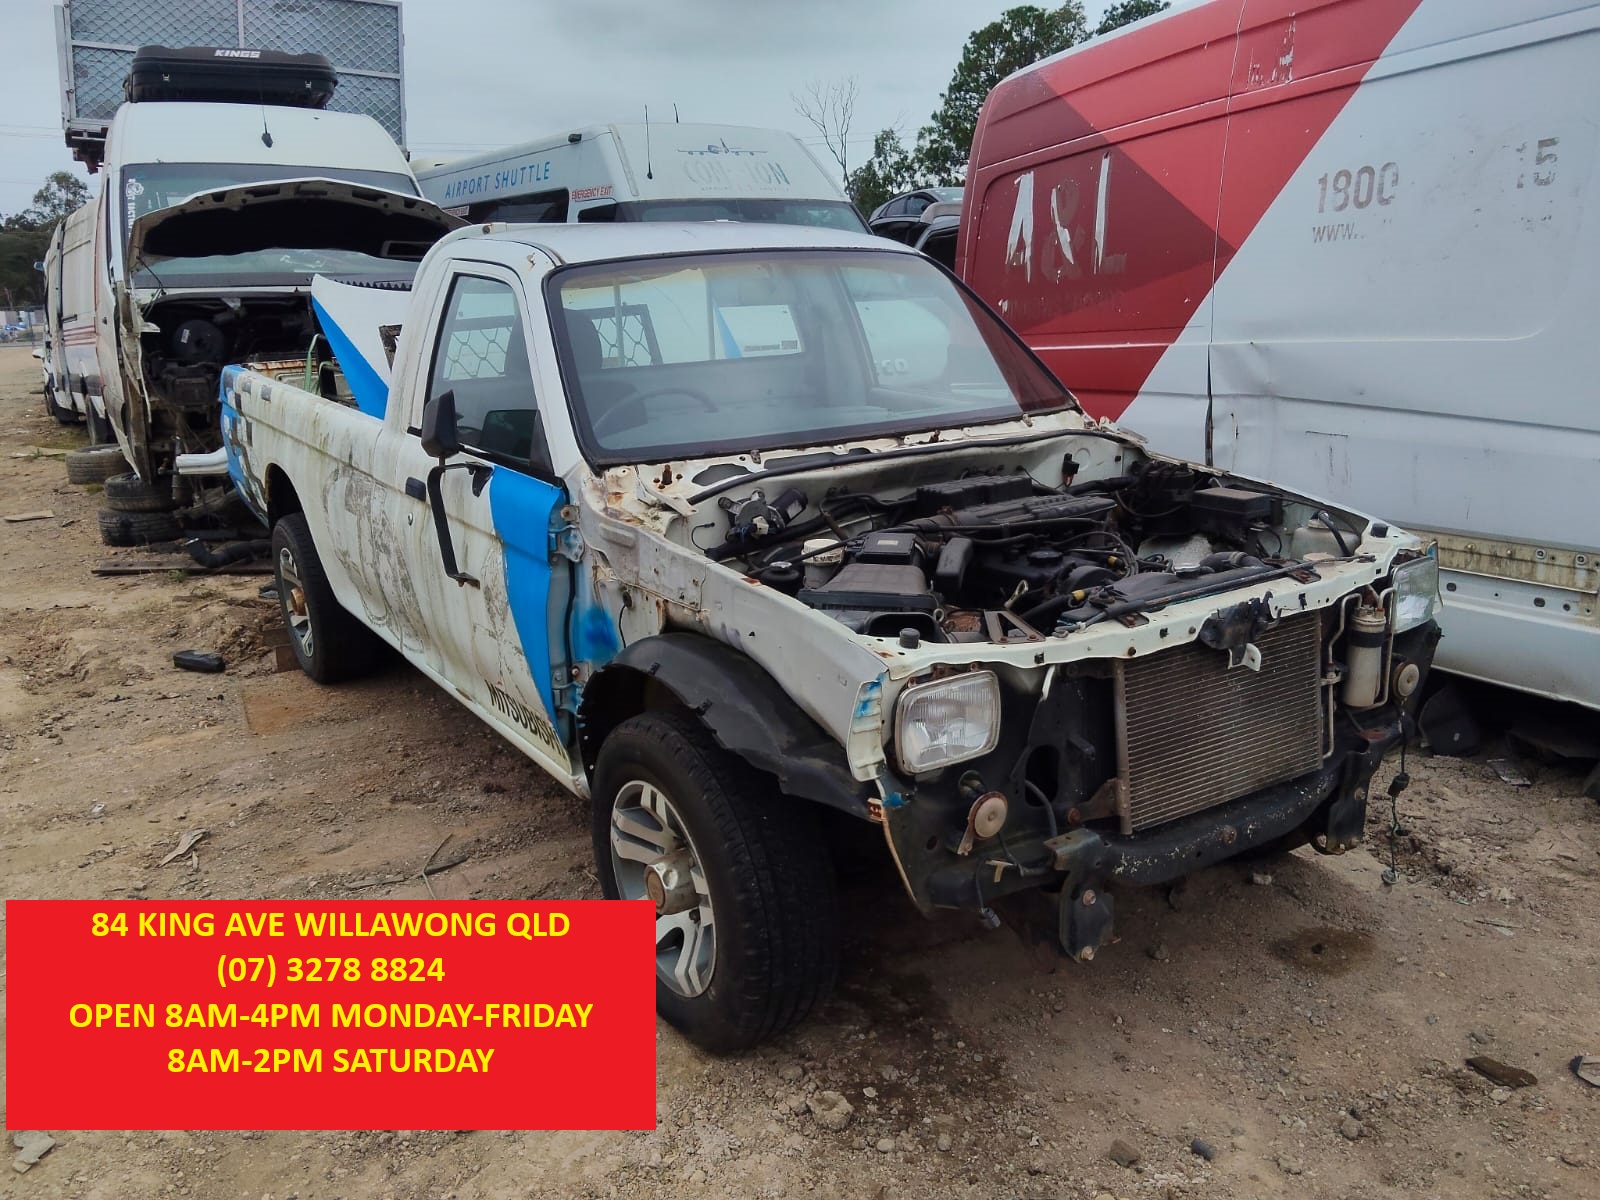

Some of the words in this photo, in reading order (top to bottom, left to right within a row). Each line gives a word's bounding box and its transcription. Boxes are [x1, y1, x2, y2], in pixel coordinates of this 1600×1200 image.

[214, 49, 261, 58] KINGS
[445, 175, 490, 198] AIRPORT
[495, 162, 550, 189] SHUTTLE
[1318, 162, 1400, 213] 1800
[572, 188, 600, 199] EMERGENCY
[600, 186, 612, 196] EXIT
